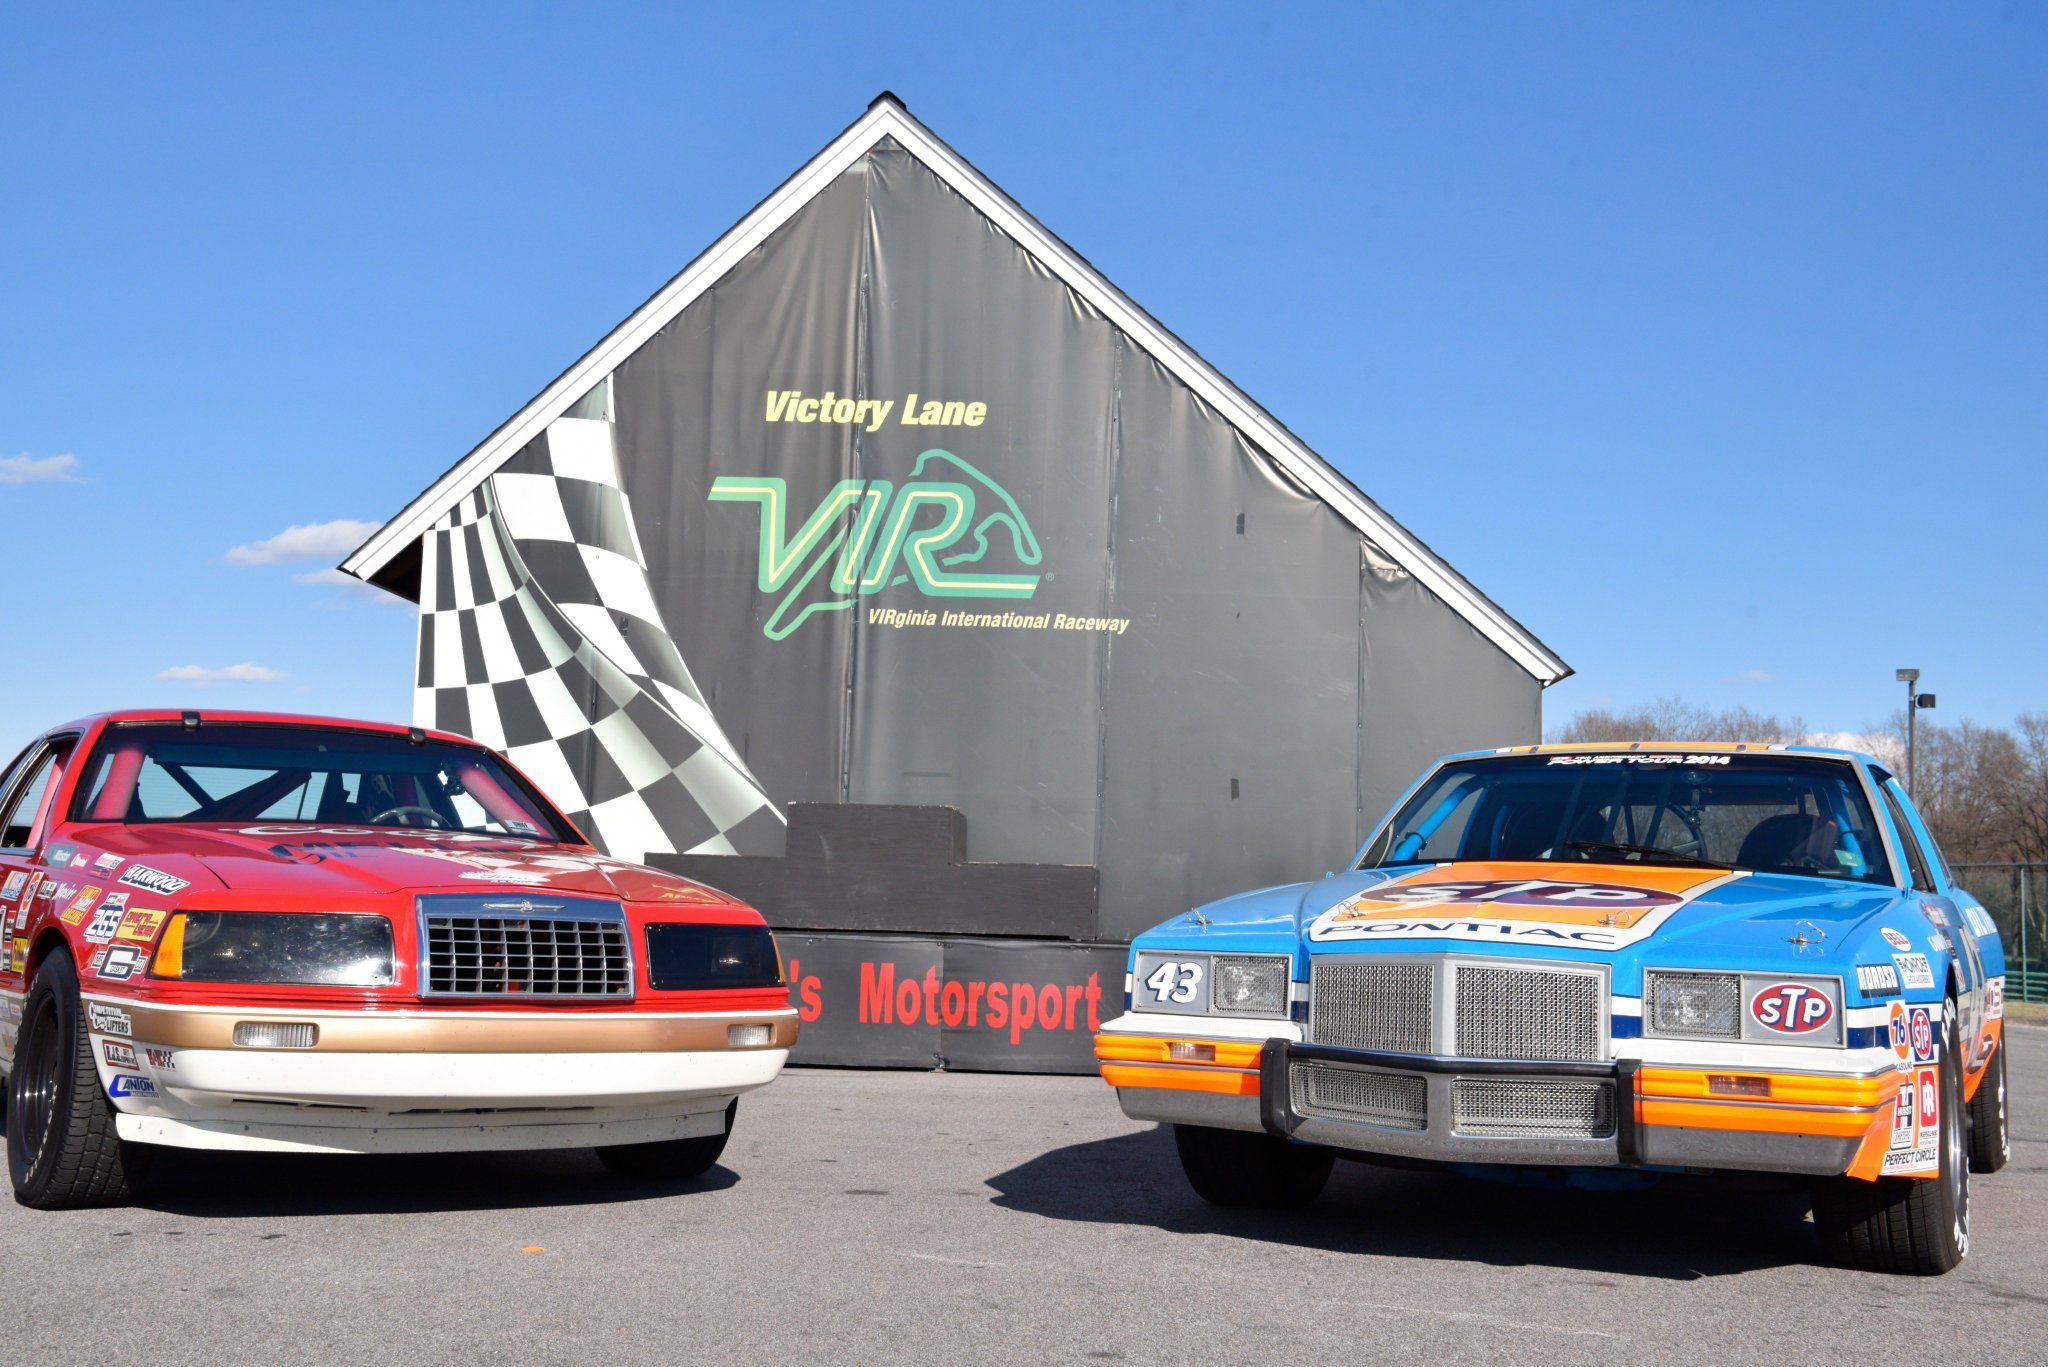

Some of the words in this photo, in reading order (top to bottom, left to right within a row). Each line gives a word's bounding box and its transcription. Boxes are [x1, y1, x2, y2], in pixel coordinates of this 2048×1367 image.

[765, 390, 894, 432] Victory
[901, 393, 988, 427] Lane
[707, 476, 1041, 599] VIR
[868, 607, 938, 629] VIRginia
[942, 610, 1050, 630] International
[1053, 612, 1130, 634] Raceway
[1547, 757, 1623, 766] POWER
[1627, 756, 1684, 764] TOUR
[1683, 755, 1731, 765] 2014
[125, 865, 187, 891] HARWOOD
[1382, 879, 1651, 902] STP
[1318, 922, 1616, 945] PONTIAC
[1883, 932, 1909, 946] BELL
[1145, 961, 1204, 1004] 43
[1856, 965, 1899, 991] MOROSO
[858, 961, 1102, 1045] Motorsport
[1759, 988, 1828, 1031] STP
[106, 1019, 129, 1034] LIFTERS
[1891, 1014, 1906, 1046] 76
[1914, 1017, 1929, 1045] STP
[109, 1073, 156, 1099] CANTON
[1884, 1151, 1916, 1167] PERFECT
[1915, 1148, 1936, 1163] CIRCLE
